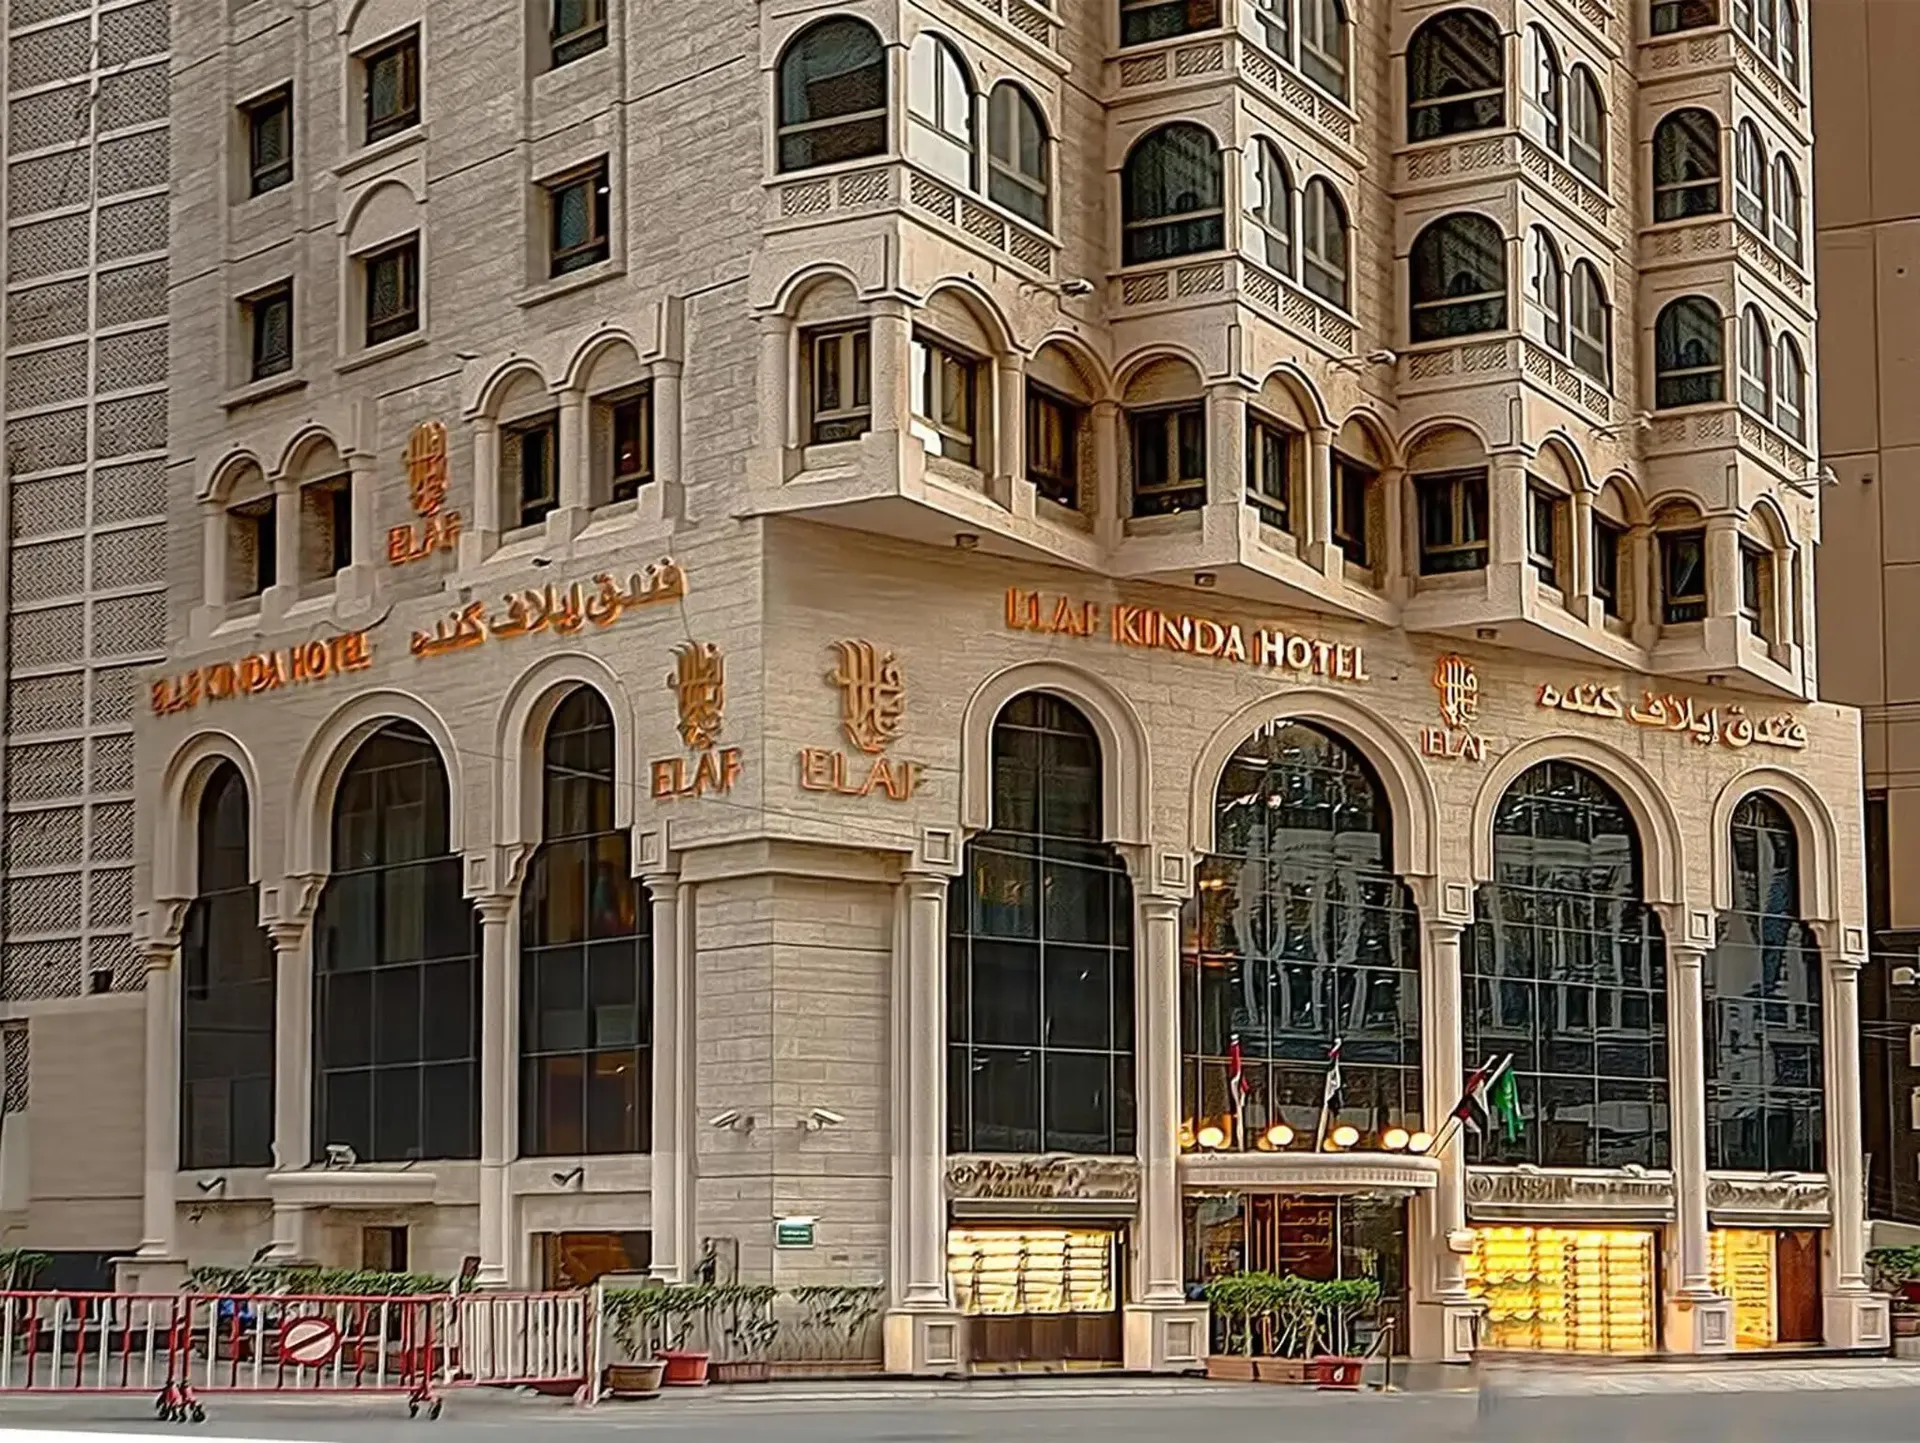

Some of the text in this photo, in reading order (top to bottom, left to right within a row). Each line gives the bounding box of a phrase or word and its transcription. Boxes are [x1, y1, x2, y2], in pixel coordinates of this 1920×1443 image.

[388, 510, 461, 566] ELAF
[586, 555, 688, 627] فندق
[1004, 586, 1371, 682] ELAF KINDA HOTEL
[203, 650, 287, 703] KINDA
[290, 630, 374, 683] HOTEL
[1420, 726, 1492, 764] ELAF
[1626, 688, 1721, 745] إيلاف
[1722, 703, 1811, 750] فندق
[650, 745, 744, 802] ELAF
[799, 747, 920, 803] ELAF
